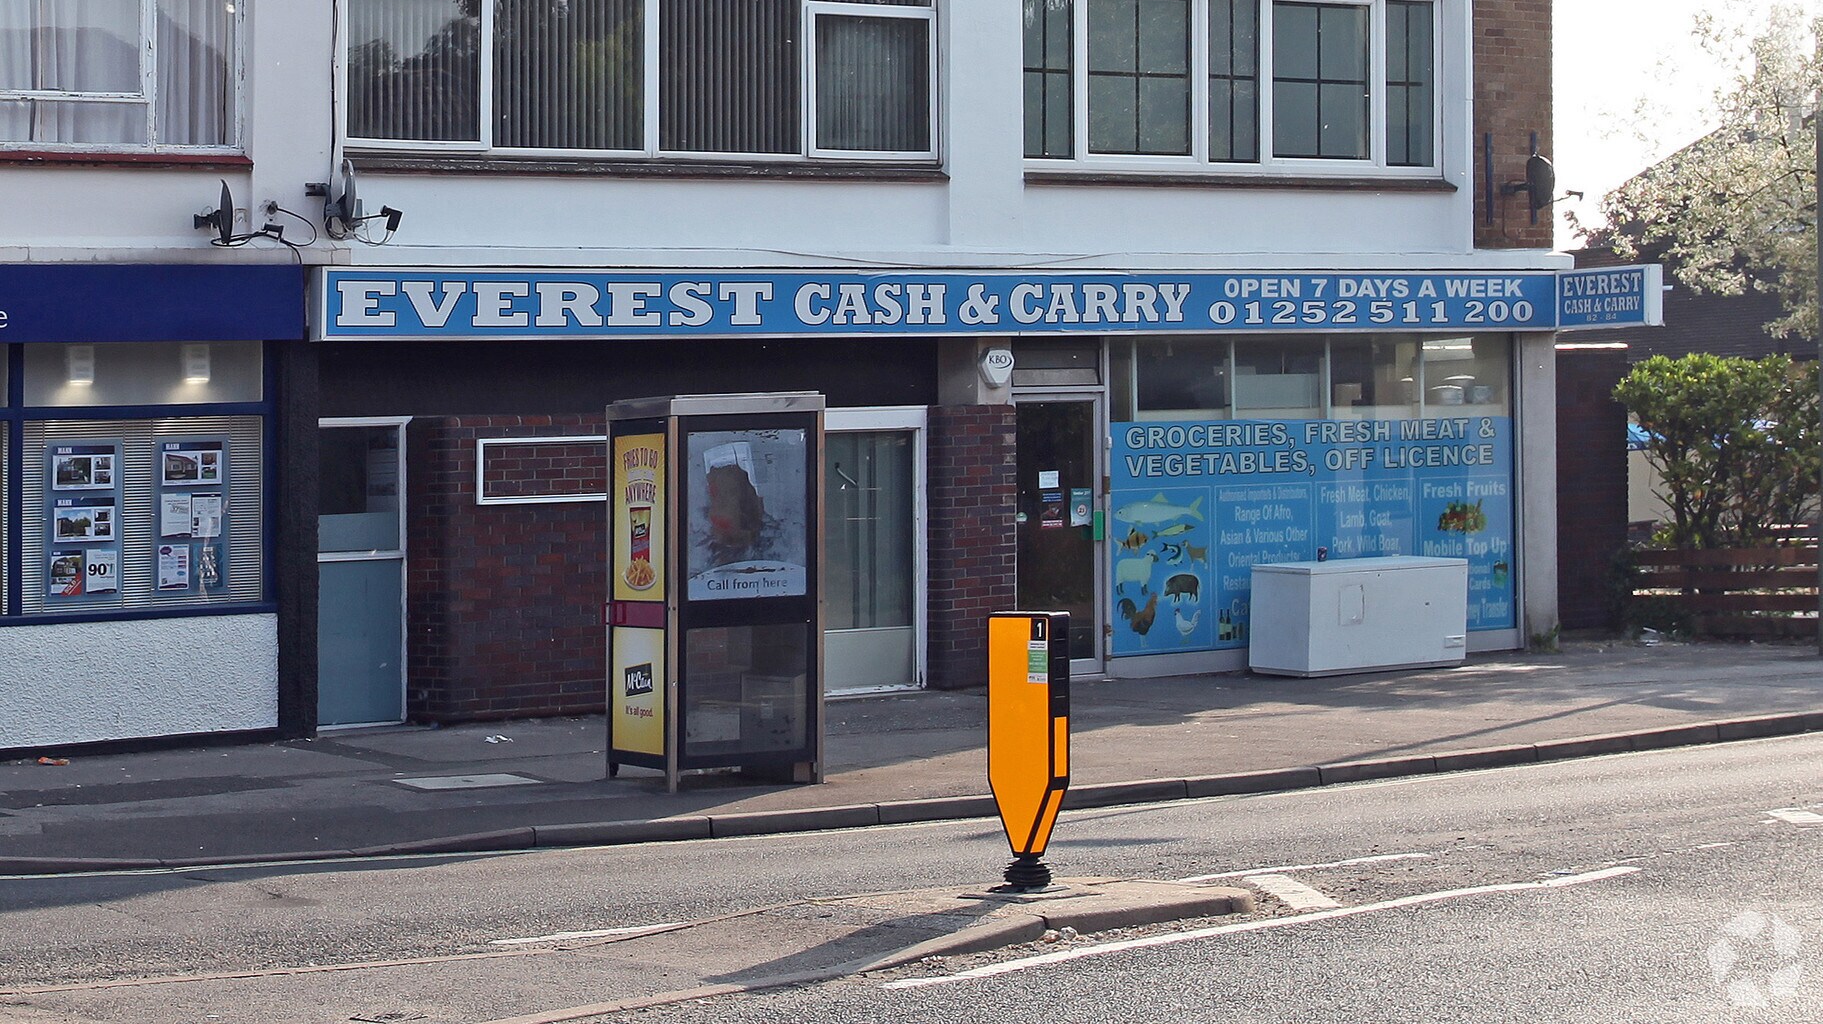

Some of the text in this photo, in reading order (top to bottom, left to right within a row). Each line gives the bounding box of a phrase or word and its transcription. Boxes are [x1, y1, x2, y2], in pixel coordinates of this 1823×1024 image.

[1224, 278, 1524, 298] OPEN 7 DAYS A WEEK
[1563, 272, 1642, 297] EVEREST
[336, 279, 1191, 327] EVEREST CASH & CARRY
[1208, 299, 1534, 325] 01252 511 200
[1564, 295, 1640, 314] CASH & CARRY
[1586, 313, 1598, 322] 82
[1605, 312, 1617, 321] 84
[988, 354, 1007, 364] KBO
[1125, 416, 1497, 451] GROCERIES, FRESH MEAT &
[1125, 443, 1494, 477] VEGETABLES, OFF LICENCE
[1320, 486, 1346, 503] Fresh
[1348, 485, 1371, 503] Meat,
[1423, 480, 1506, 499] Fresh Fruits
[1234, 504, 1293, 525] Range Of Afro,
[1340, 509, 1393, 530] Lamb, Goat,
[1220, 526, 1308, 545] Asian & Various Other
[1356, 534, 1376, 552] Wild
[1379, 534, 1401, 551] Boar,
[1423, 537, 1507, 559] Mobile Top Up
[1228, 551, 1261, 568] Oriental
[707, 576, 788, 591] Call from here
[1036, 622, 1042, 638] 1
